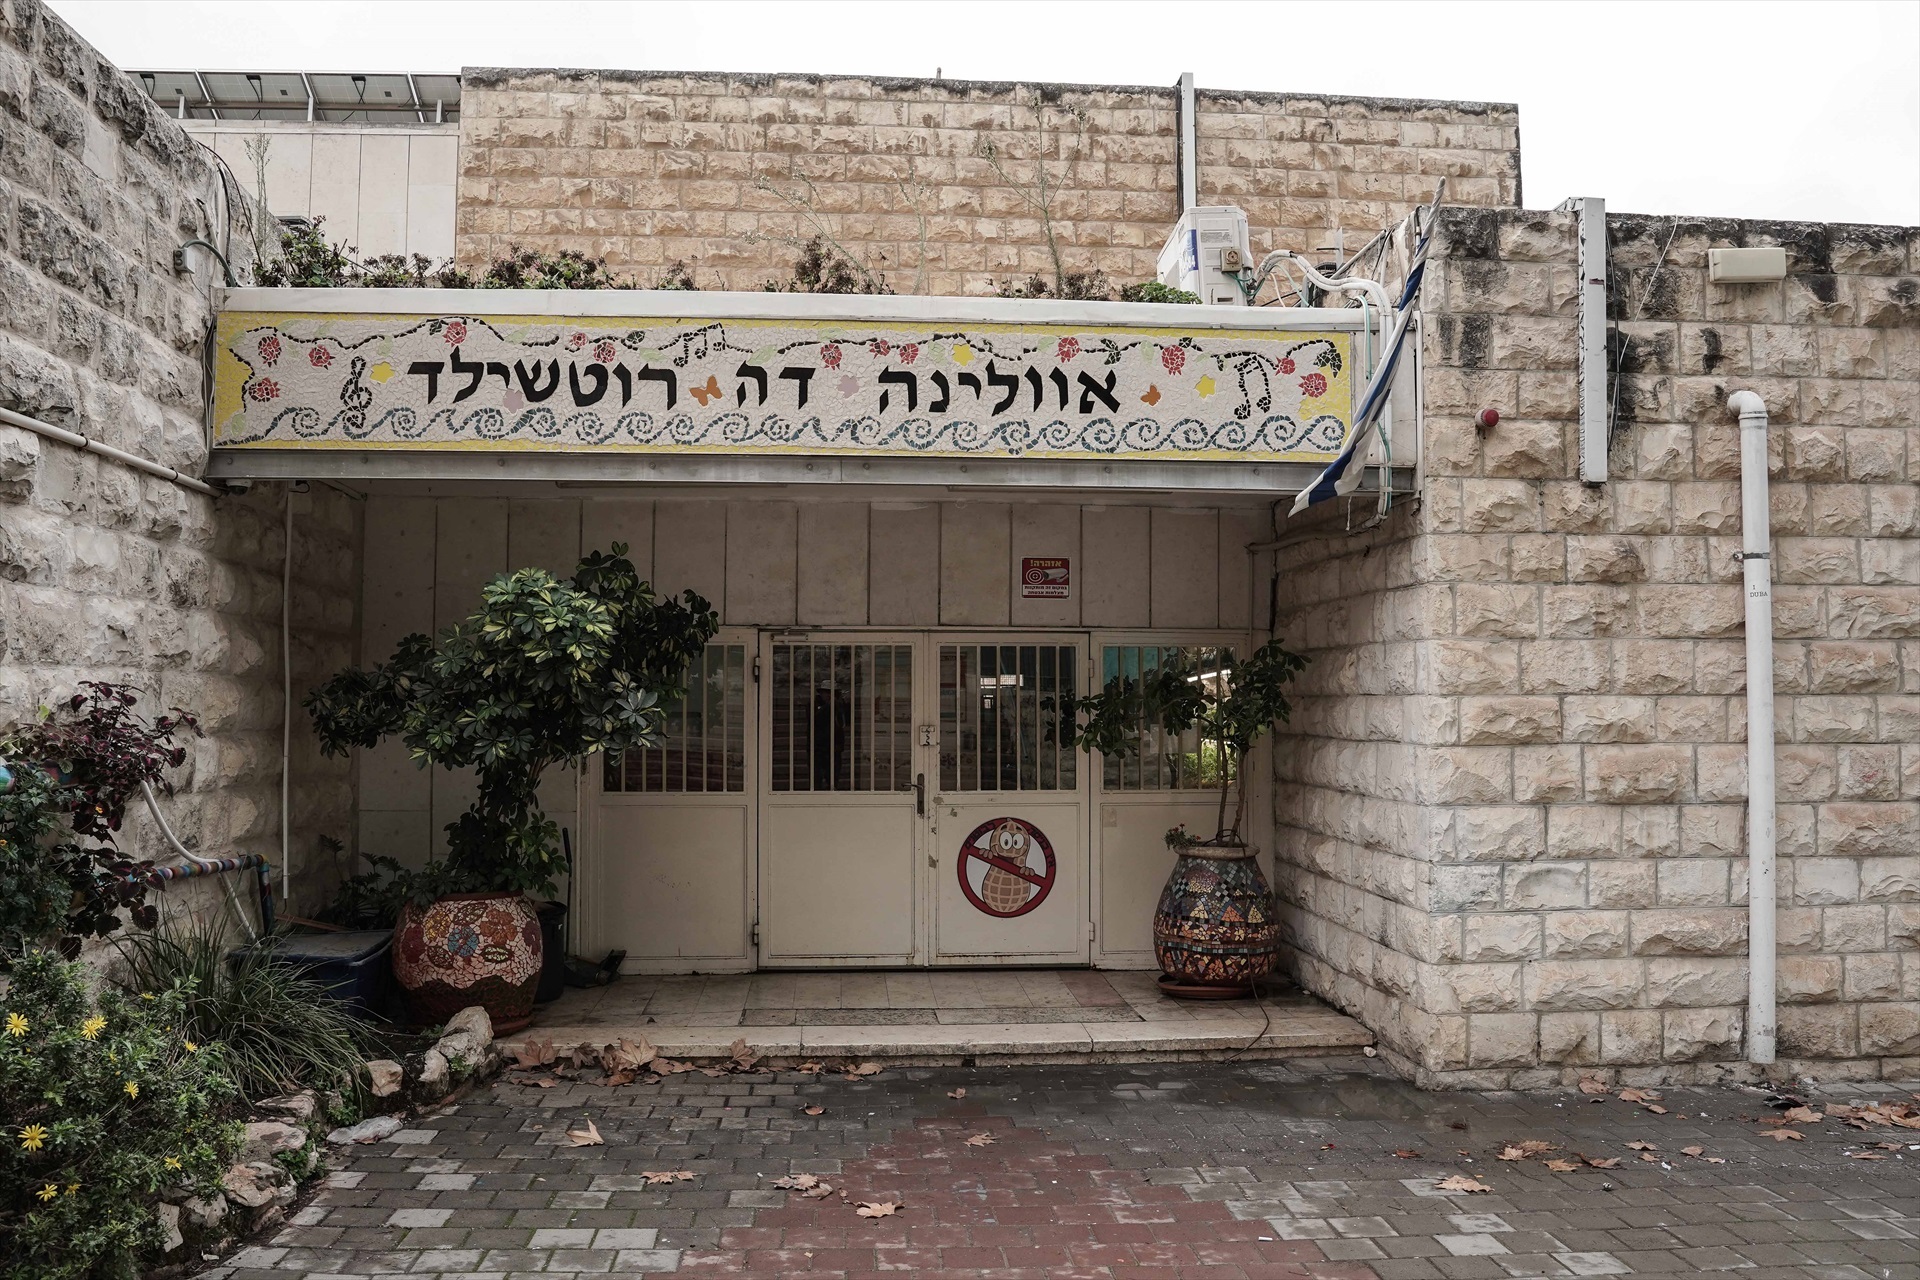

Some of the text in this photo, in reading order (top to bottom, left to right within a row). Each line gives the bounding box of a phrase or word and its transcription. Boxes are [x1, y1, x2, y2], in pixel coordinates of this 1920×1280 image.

[406, 345, 1121, 416] אוולינה דה רוטשילד
[1030, 559, 1062, 567] אזהרה!
